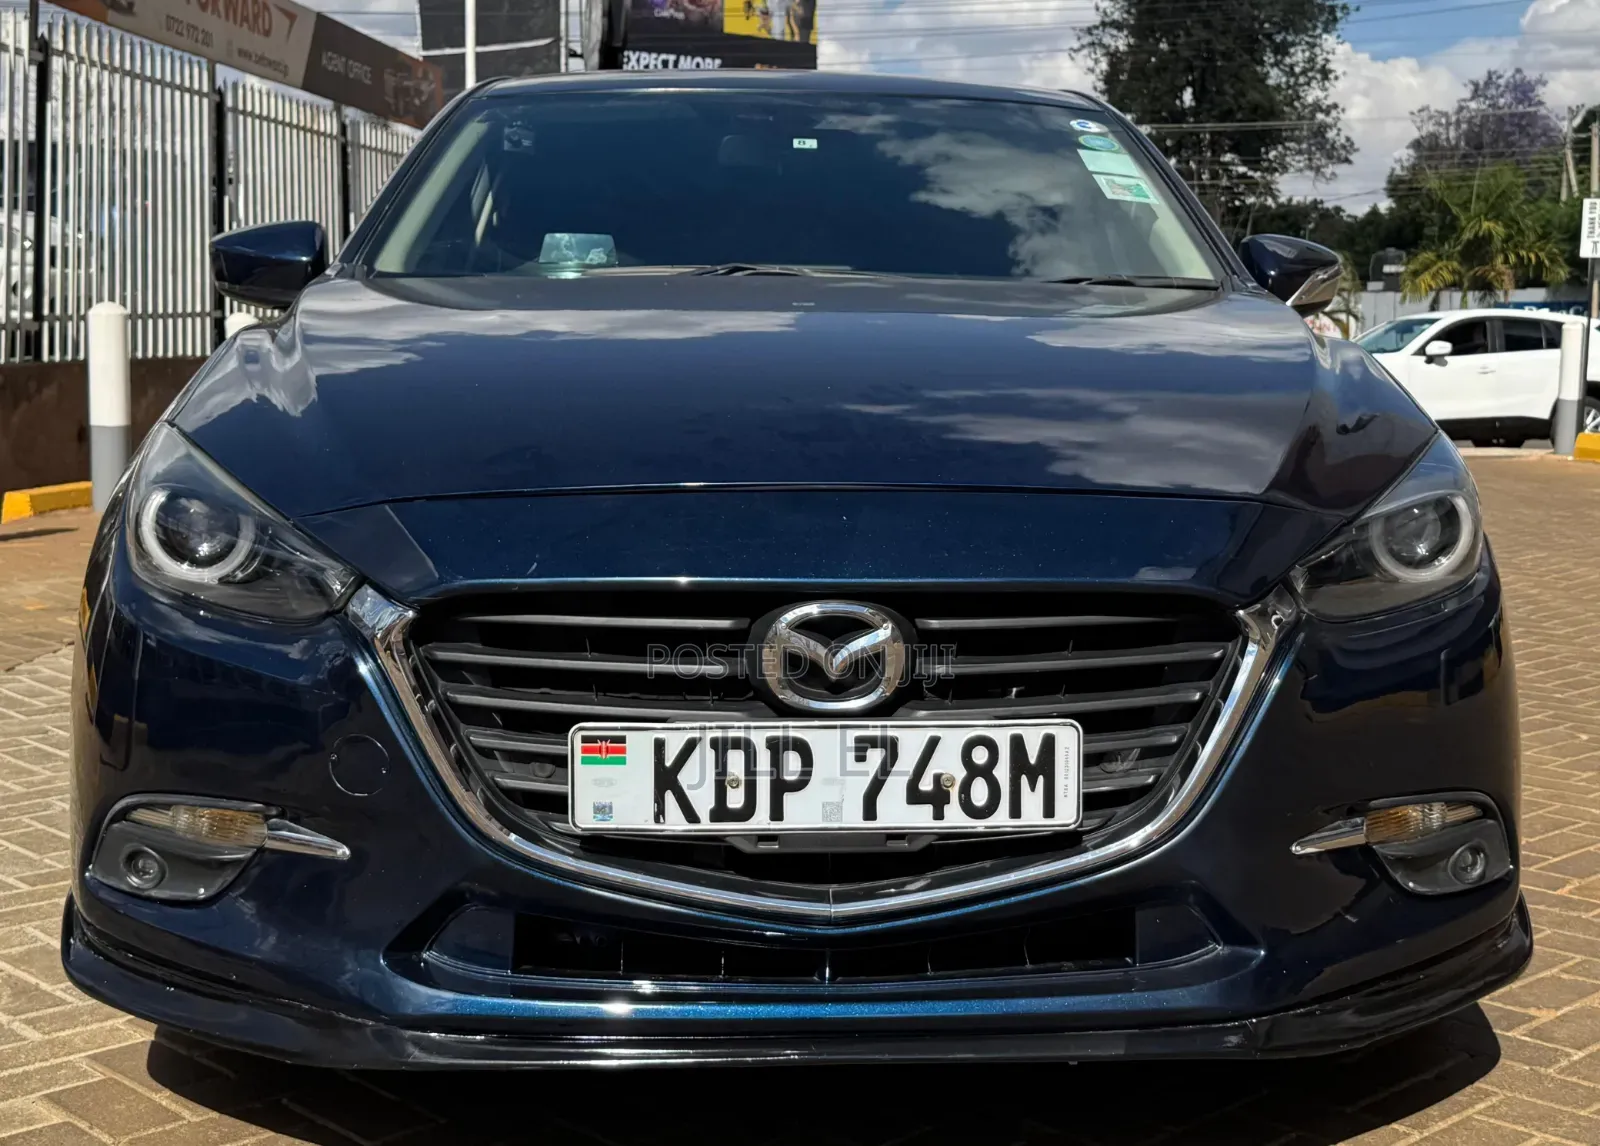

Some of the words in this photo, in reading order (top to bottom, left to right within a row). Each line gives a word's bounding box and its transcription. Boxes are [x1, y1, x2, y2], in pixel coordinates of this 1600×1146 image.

[187, 0, 273, 37] WARD
[322, 51, 345, 75] AGENT
[347, 60, 372, 84] OFFICE
[1589, 201, 1597, 214] YOU
[1587, 216, 1596, 239] THANK
[653, 734, 814, 824] KDP
[853, 732, 1056, 822] 748M
